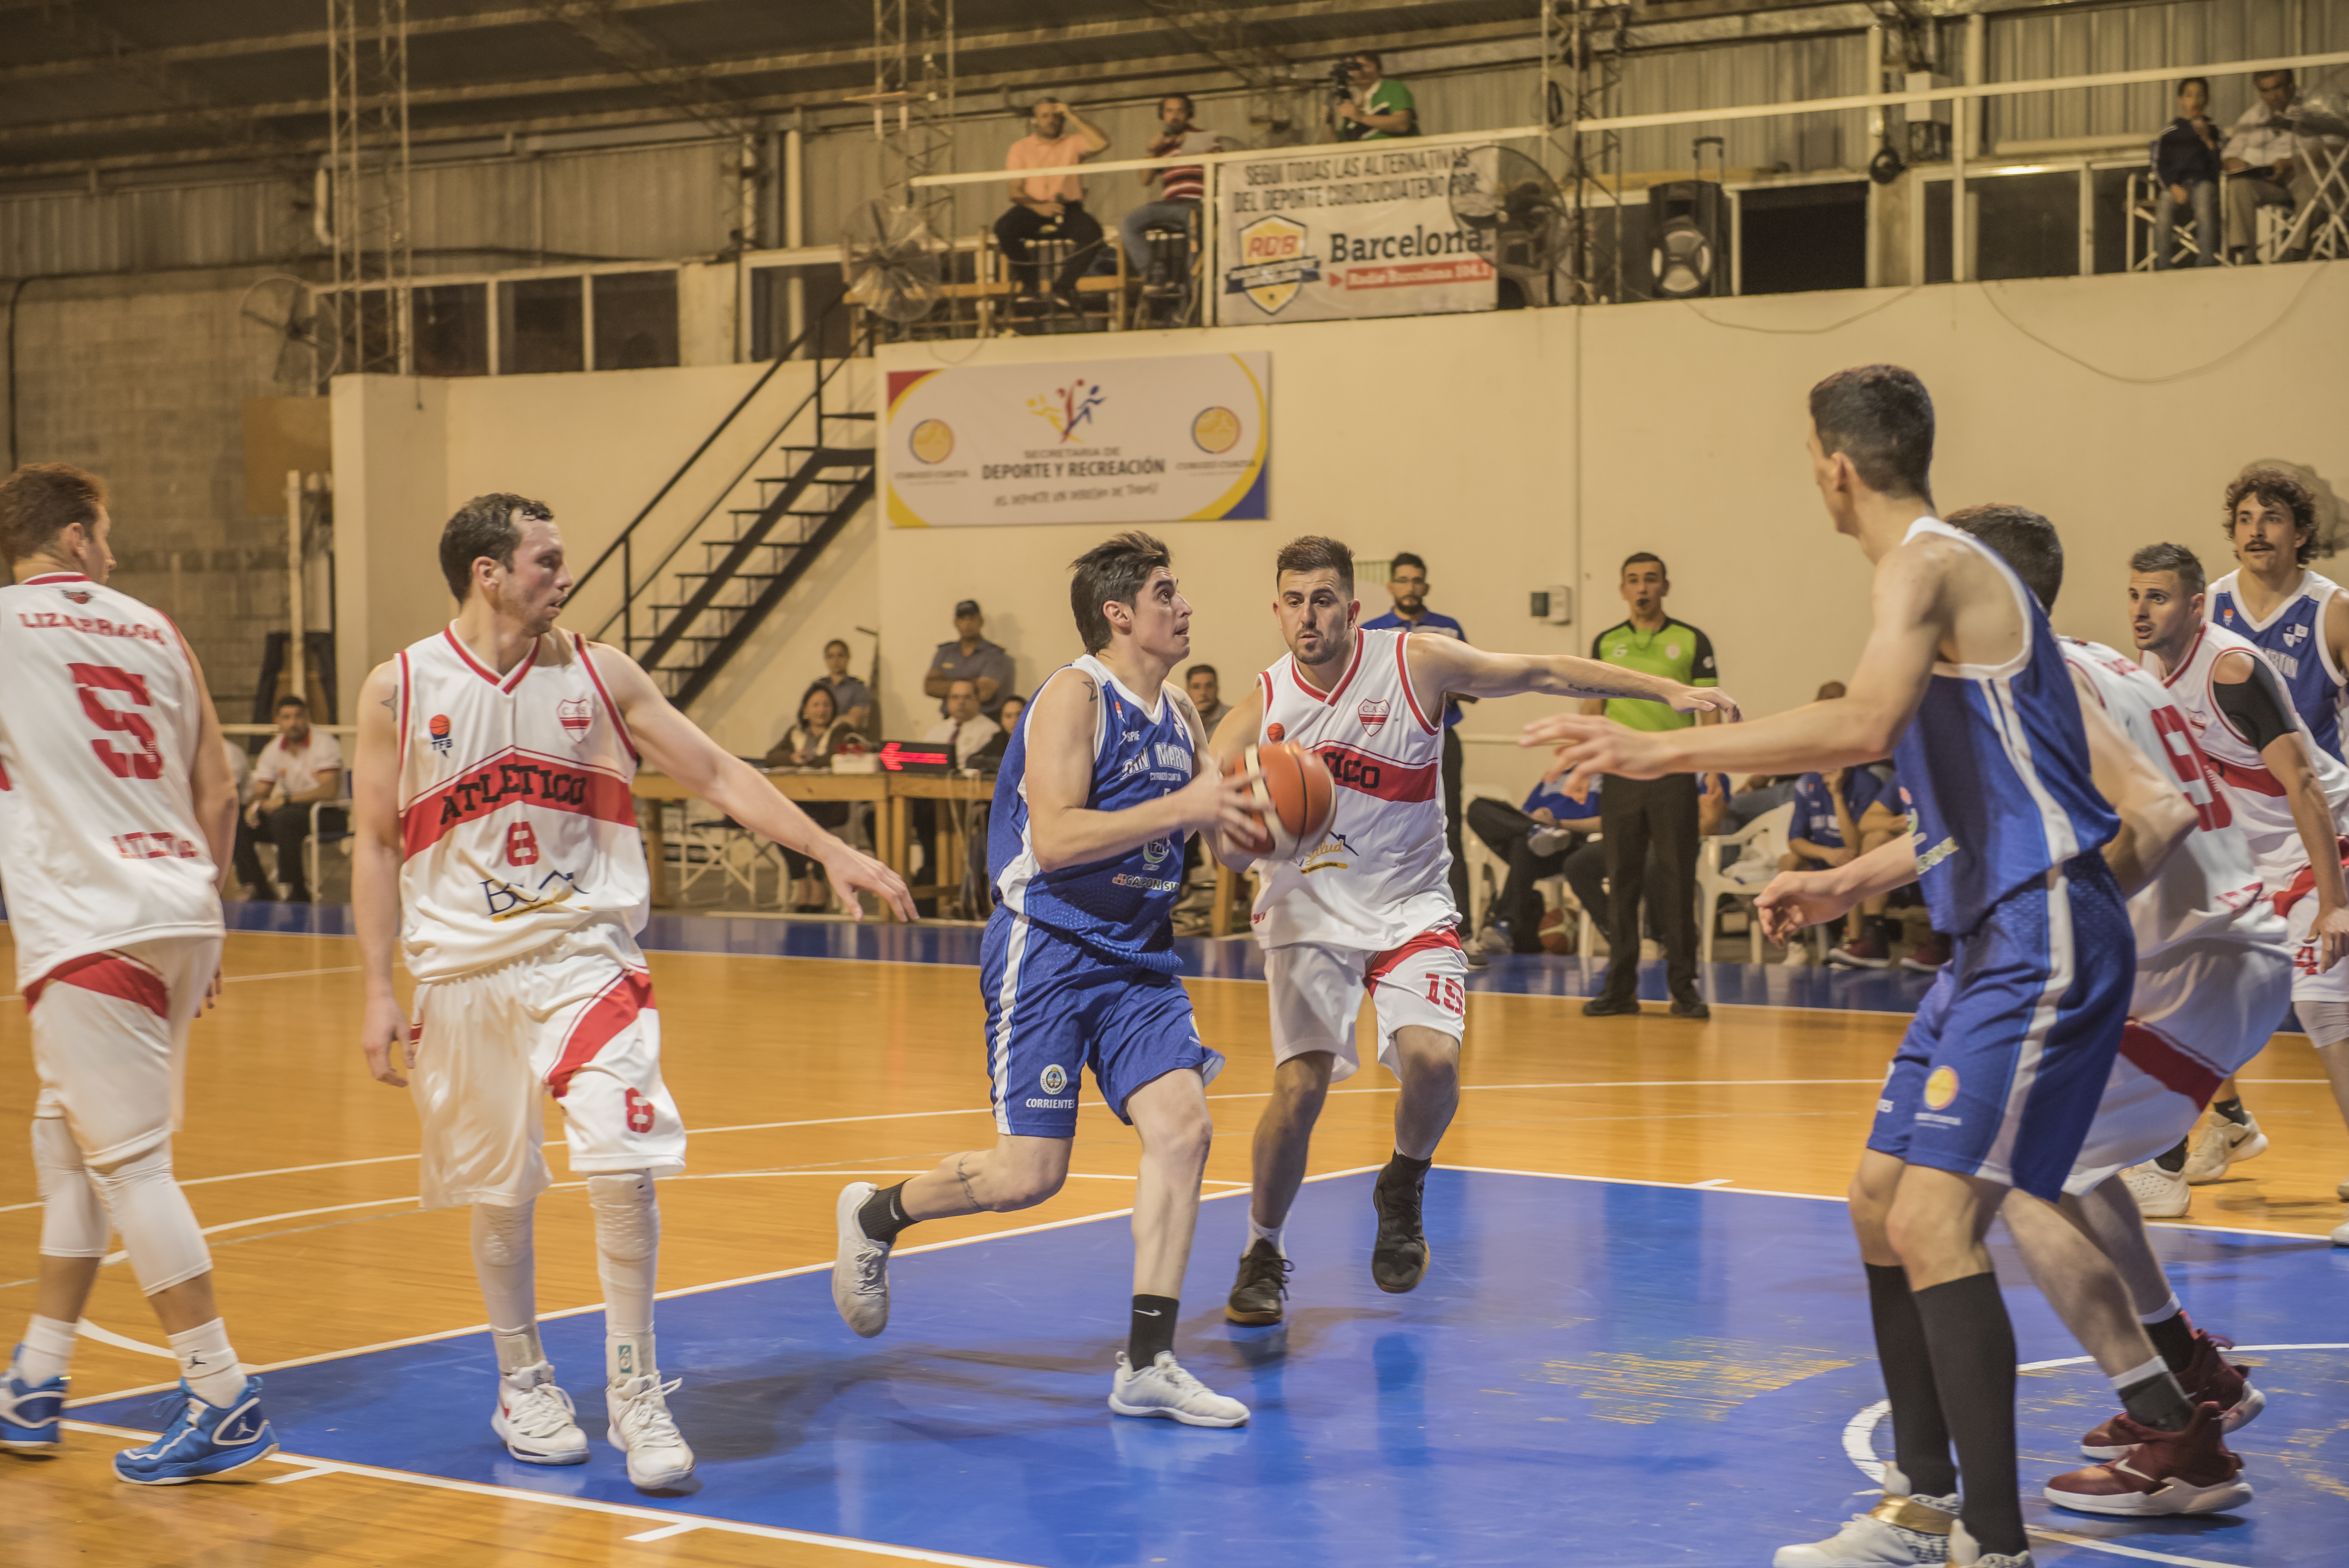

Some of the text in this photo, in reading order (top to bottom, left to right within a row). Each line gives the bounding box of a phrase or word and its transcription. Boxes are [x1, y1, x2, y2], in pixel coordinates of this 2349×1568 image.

[1288, 160, 1330, 182] TODAS
[1335, 157, 1359, 178] LAS
[1234, 192, 1257, 213] DEL
[1264, 186, 1322, 211] DEPORTE
[1248, 234, 1298, 257] RDB
[1104, 447, 1120, 456] DE
[982, 463, 1051, 479] DEPORTE
[1055, 463, 1064, 478] Y
[1068, 456, 1166, 477] RECREACIÓN
[67, 663, 164, 780] 5
[440, 763, 586, 826] ATLETICO
[506, 821, 540, 867] 8
[2295, 946, 2319, 975] 4
[1425, 972, 1463, 1016] 15
[625, 1087, 655, 1133] 8
[1025, 1098, 1075, 1109] CORRIENTES
